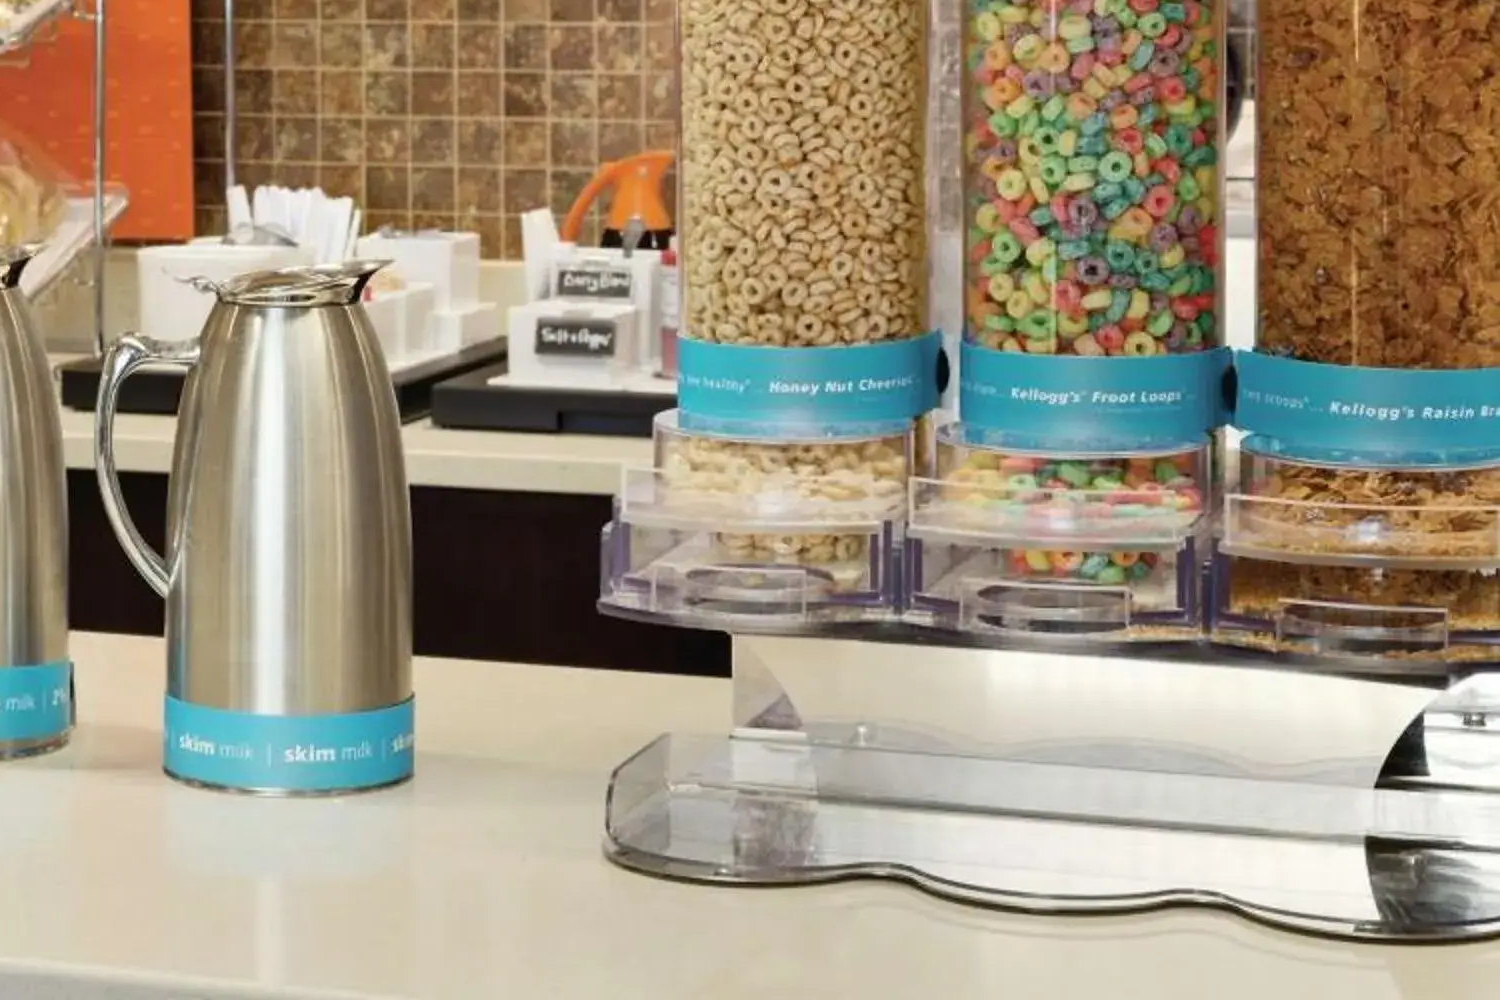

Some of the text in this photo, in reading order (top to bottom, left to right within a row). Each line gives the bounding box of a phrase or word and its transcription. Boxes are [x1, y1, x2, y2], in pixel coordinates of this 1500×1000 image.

[769, 380, 819, 396] Honey
[824, 379, 853, 393] Nut
[1092, 391, 1137, 404] Froot
[1140, 390, 1182, 405] Loops
[1422, 404, 1476, 421] Raisin
[179, 732, 216, 757] skim
[284, 743, 336, 763] skim
[341, 740, 373, 761] milk
